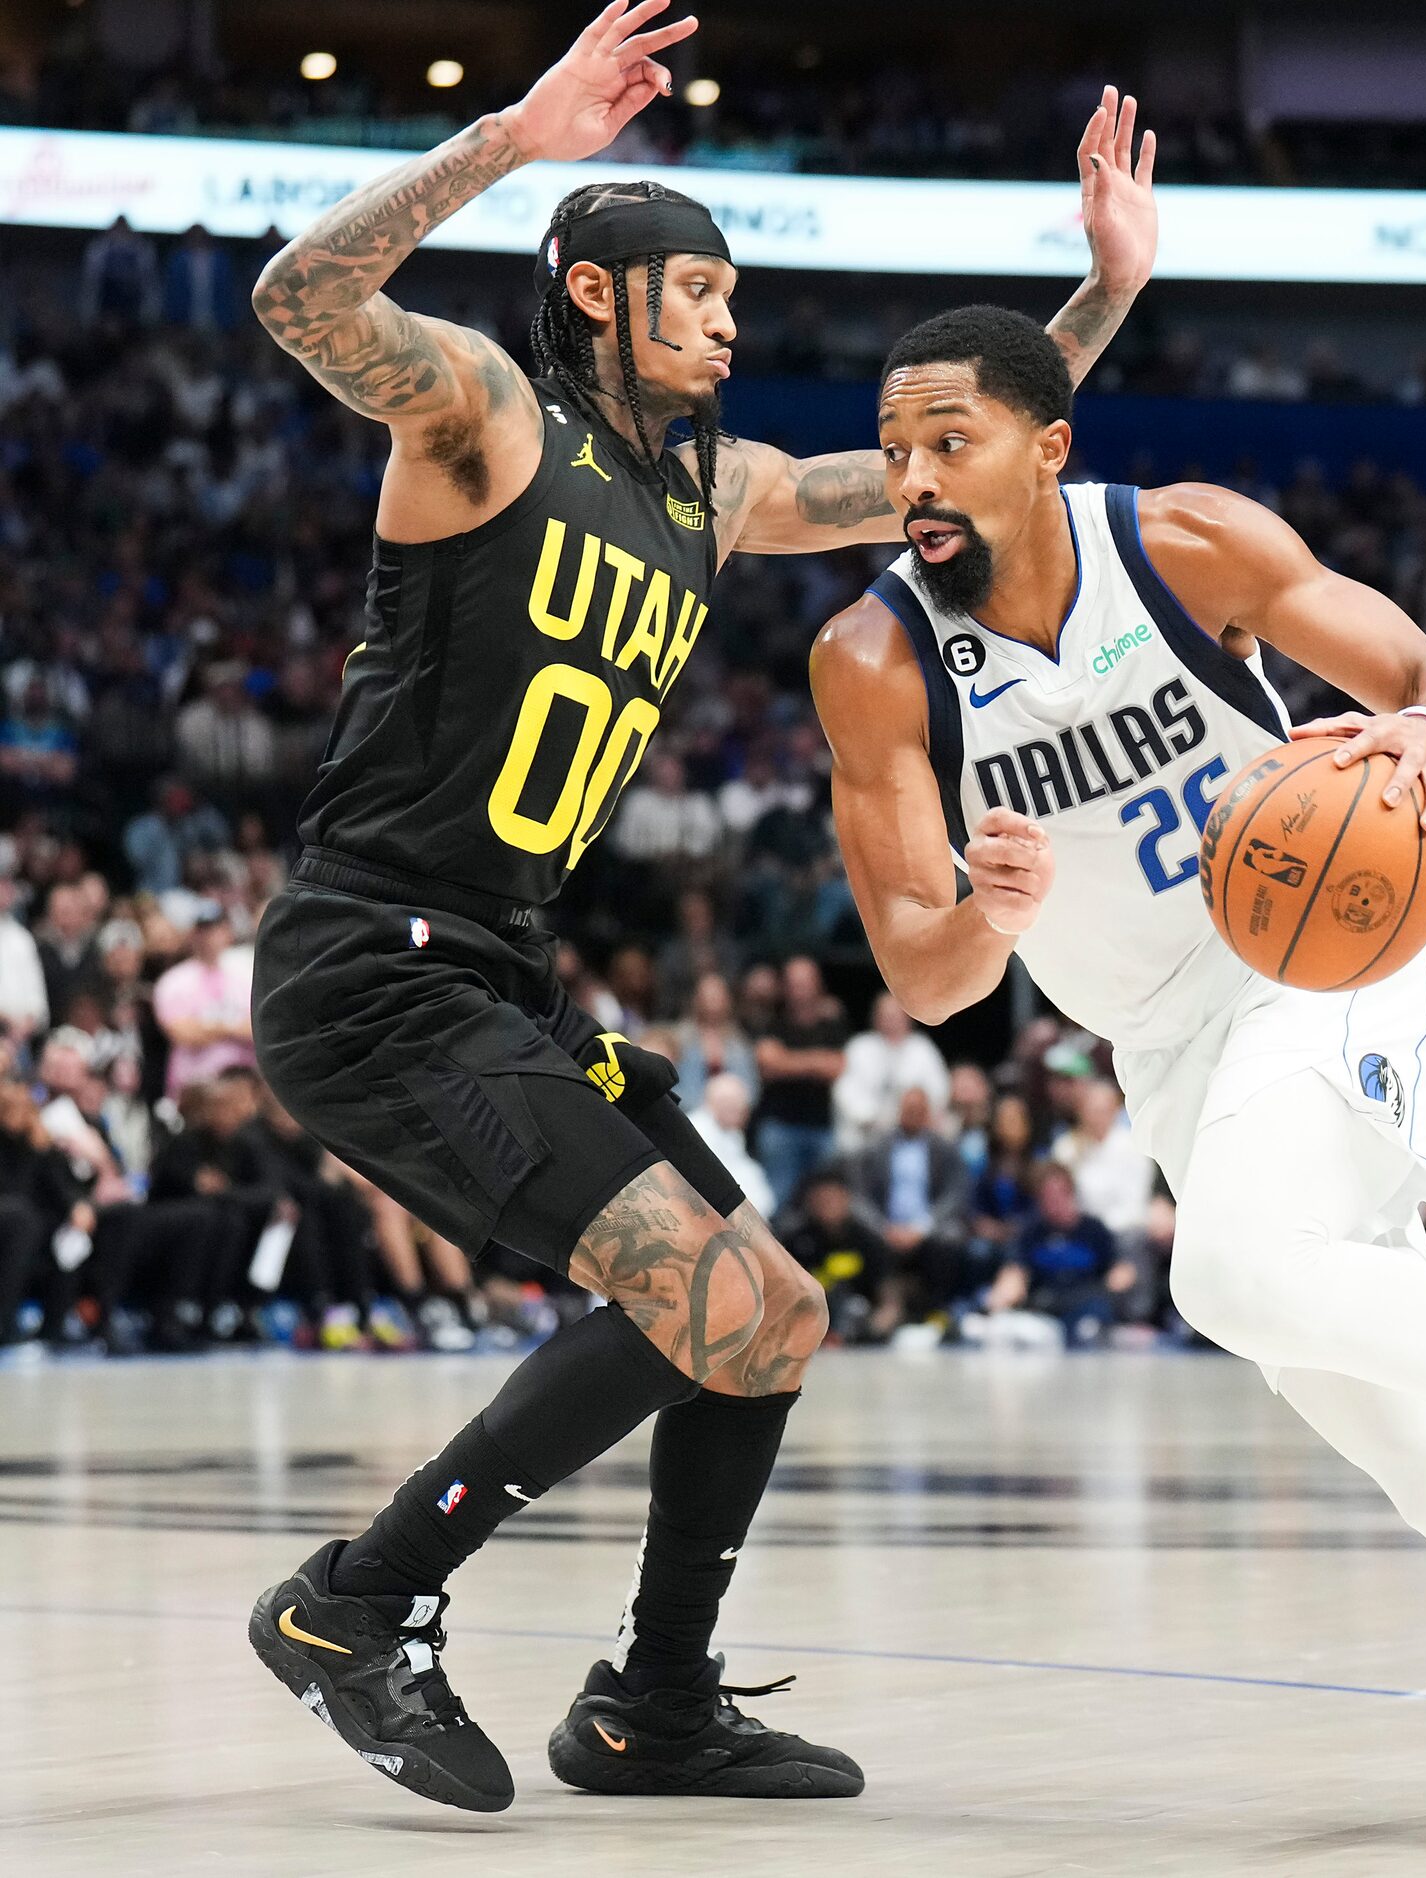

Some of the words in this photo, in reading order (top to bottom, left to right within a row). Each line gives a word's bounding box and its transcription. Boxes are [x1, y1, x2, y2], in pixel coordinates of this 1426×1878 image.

[674, 511, 700, 527] FIGHT
[528, 518, 709, 704] UTAH
[950, 640, 977, 673] 6
[1092, 624, 1153, 674] chime
[488, 663, 660, 870] 00
[971, 674, 1209, 820] DALLAS
